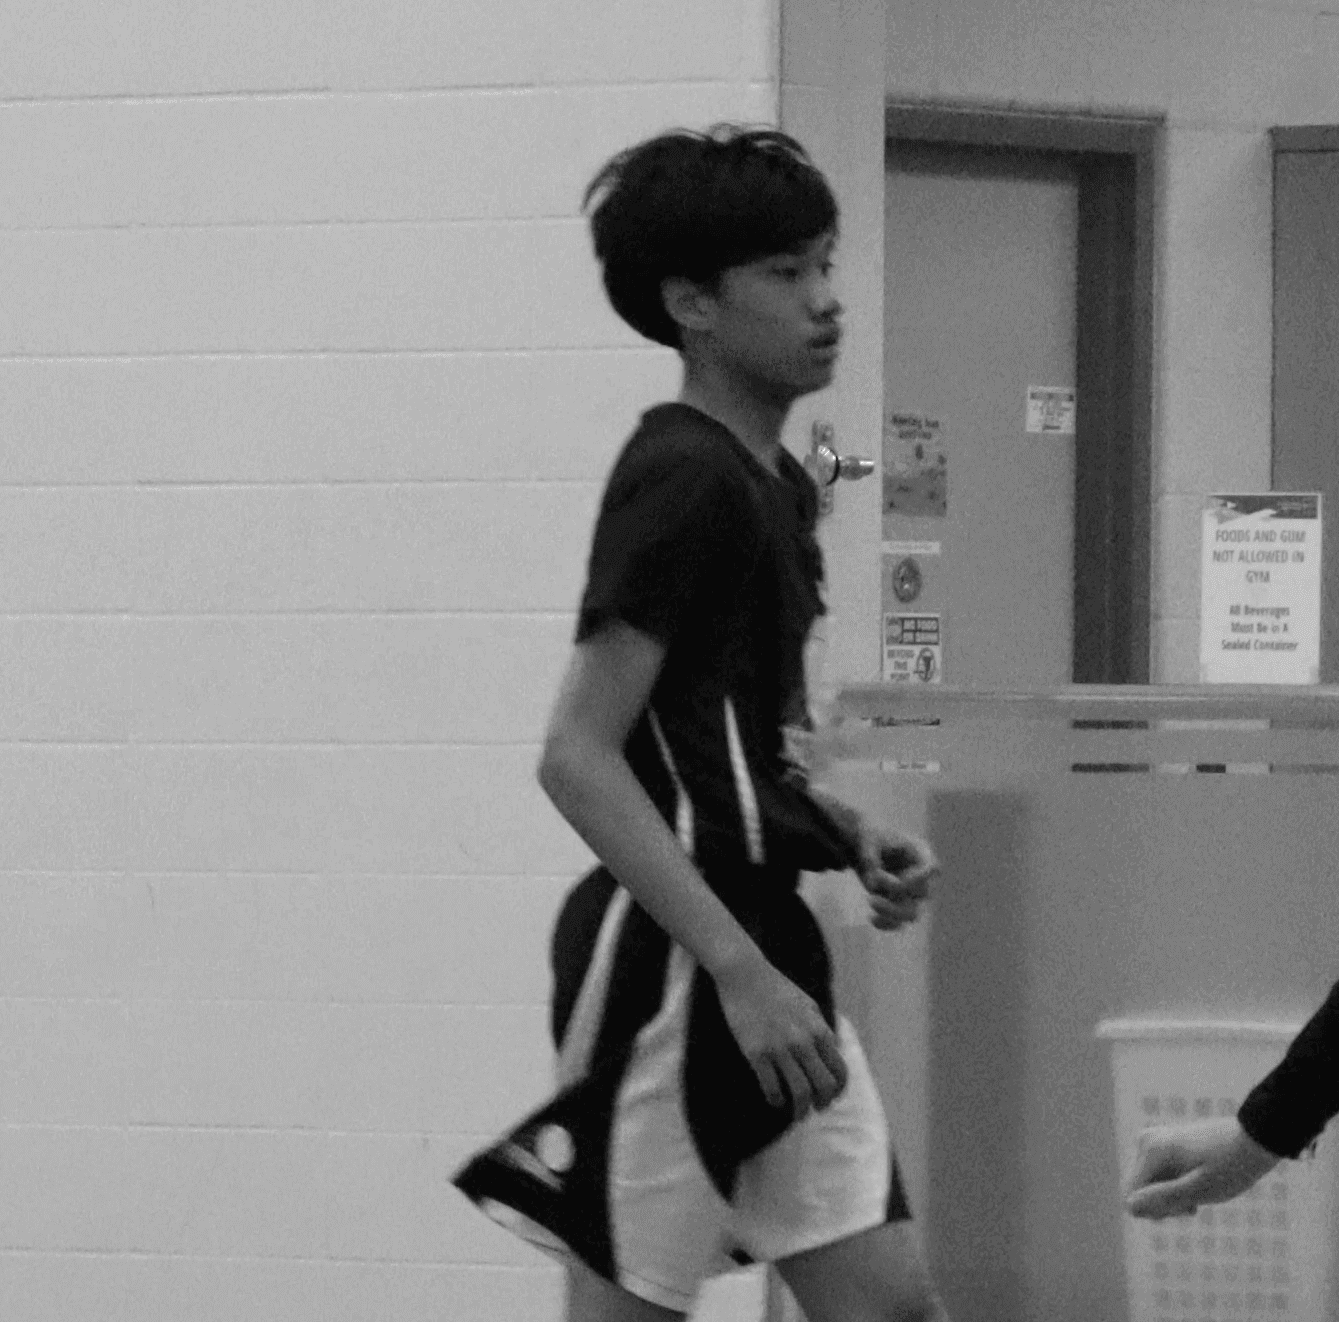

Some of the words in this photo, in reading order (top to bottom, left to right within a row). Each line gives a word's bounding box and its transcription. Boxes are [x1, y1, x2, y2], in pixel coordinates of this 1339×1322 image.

[1254, 529, 1277, 543] AND
[1280, 529, 1306, 543] GUM
[1212, 549, 1235, 564] NOT
[1238, 549, 1289, 564] ALLOWED
[1245, 570, 1271, 584] GYM
[1244, 605, 1291, 619] Beverages
[1231, 621, 1255, 634] Must
[1256, 621, 1268, 634] Be
[1221, 639, 1251, 651] Sealed
[1254, 639, 1298, 652] Container
